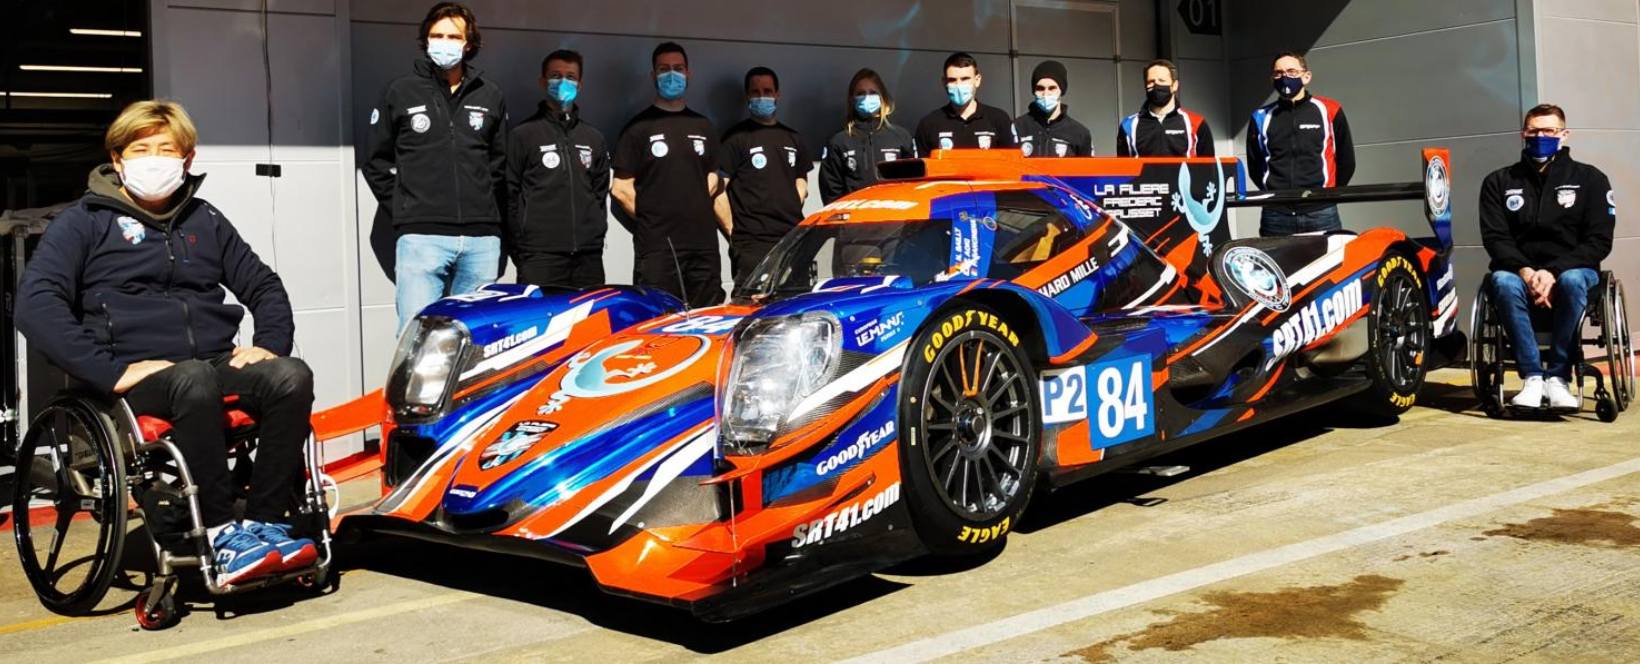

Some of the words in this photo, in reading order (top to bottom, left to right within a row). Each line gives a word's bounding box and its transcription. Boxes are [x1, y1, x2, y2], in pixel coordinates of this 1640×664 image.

[1094, 184, 1115, 196] LA
[1069, 256, 1099, 284] MILLE
[483, 325, 538, 359] SRT41.com
[924, 309, 1020, 364] GOODYEAR
[1270, 278, 1363, 363] SRT41.com
[1043, 373, 1084, 416] P2
[1097, 361, 1147, 438] 84
[816, 420, 895, 476] GOODYEAR
[791, 482, 900, 549] SRT41.com
[957, 515, 1010, 544] EAGLE
